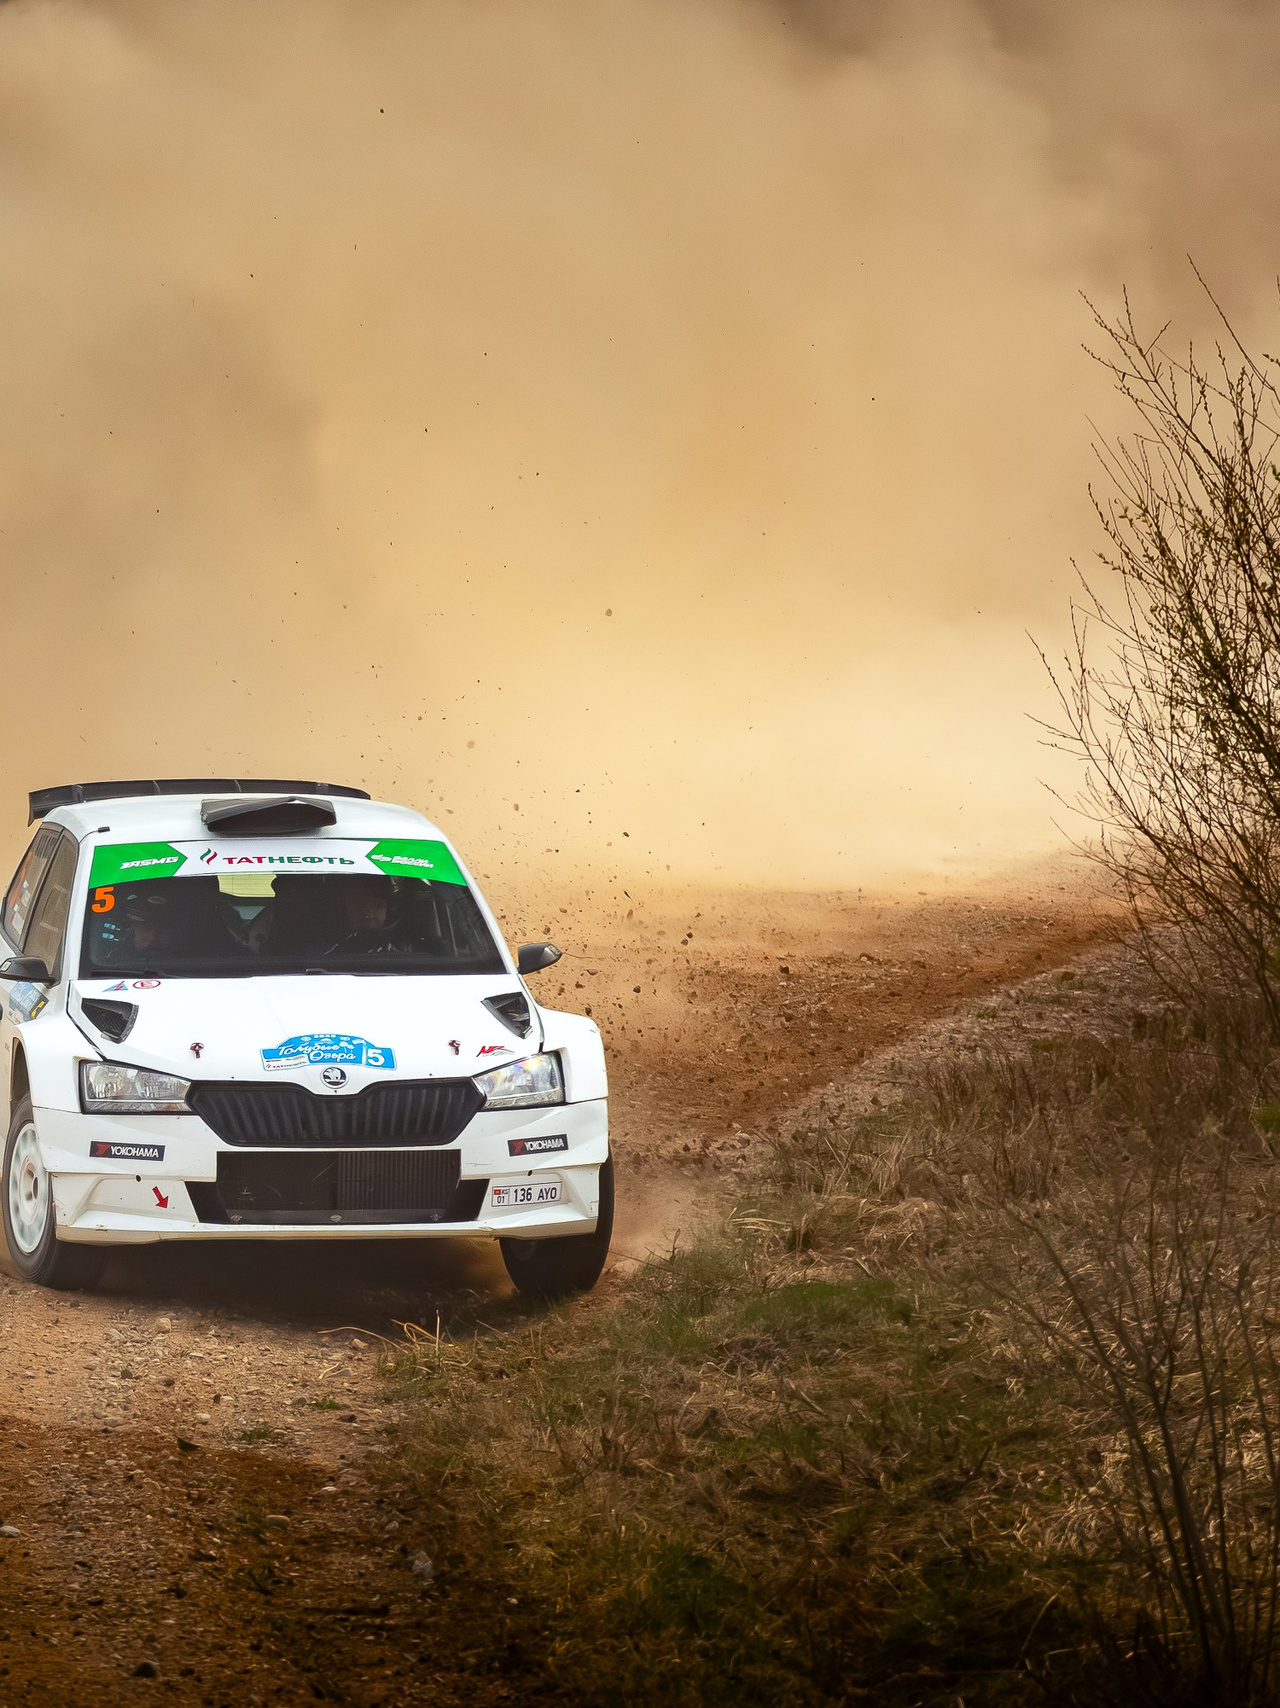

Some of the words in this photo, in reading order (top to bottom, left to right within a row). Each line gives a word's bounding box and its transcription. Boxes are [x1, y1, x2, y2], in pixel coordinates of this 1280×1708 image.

[222, 856, 355, 865] ТАТНЕФТЬ
[91, 886, 116, 913] 5
[367, 1049, 385, 1066] 5
[110, 1146, 159, 1157] YOKOHAMA
[524, 1139, 564, 1151] YOKOHAMA
[496, 1195, 505, 1204] 01
[513, 1187, 533, 1203] 136
[537, 1187, 557, 1201] AYO
